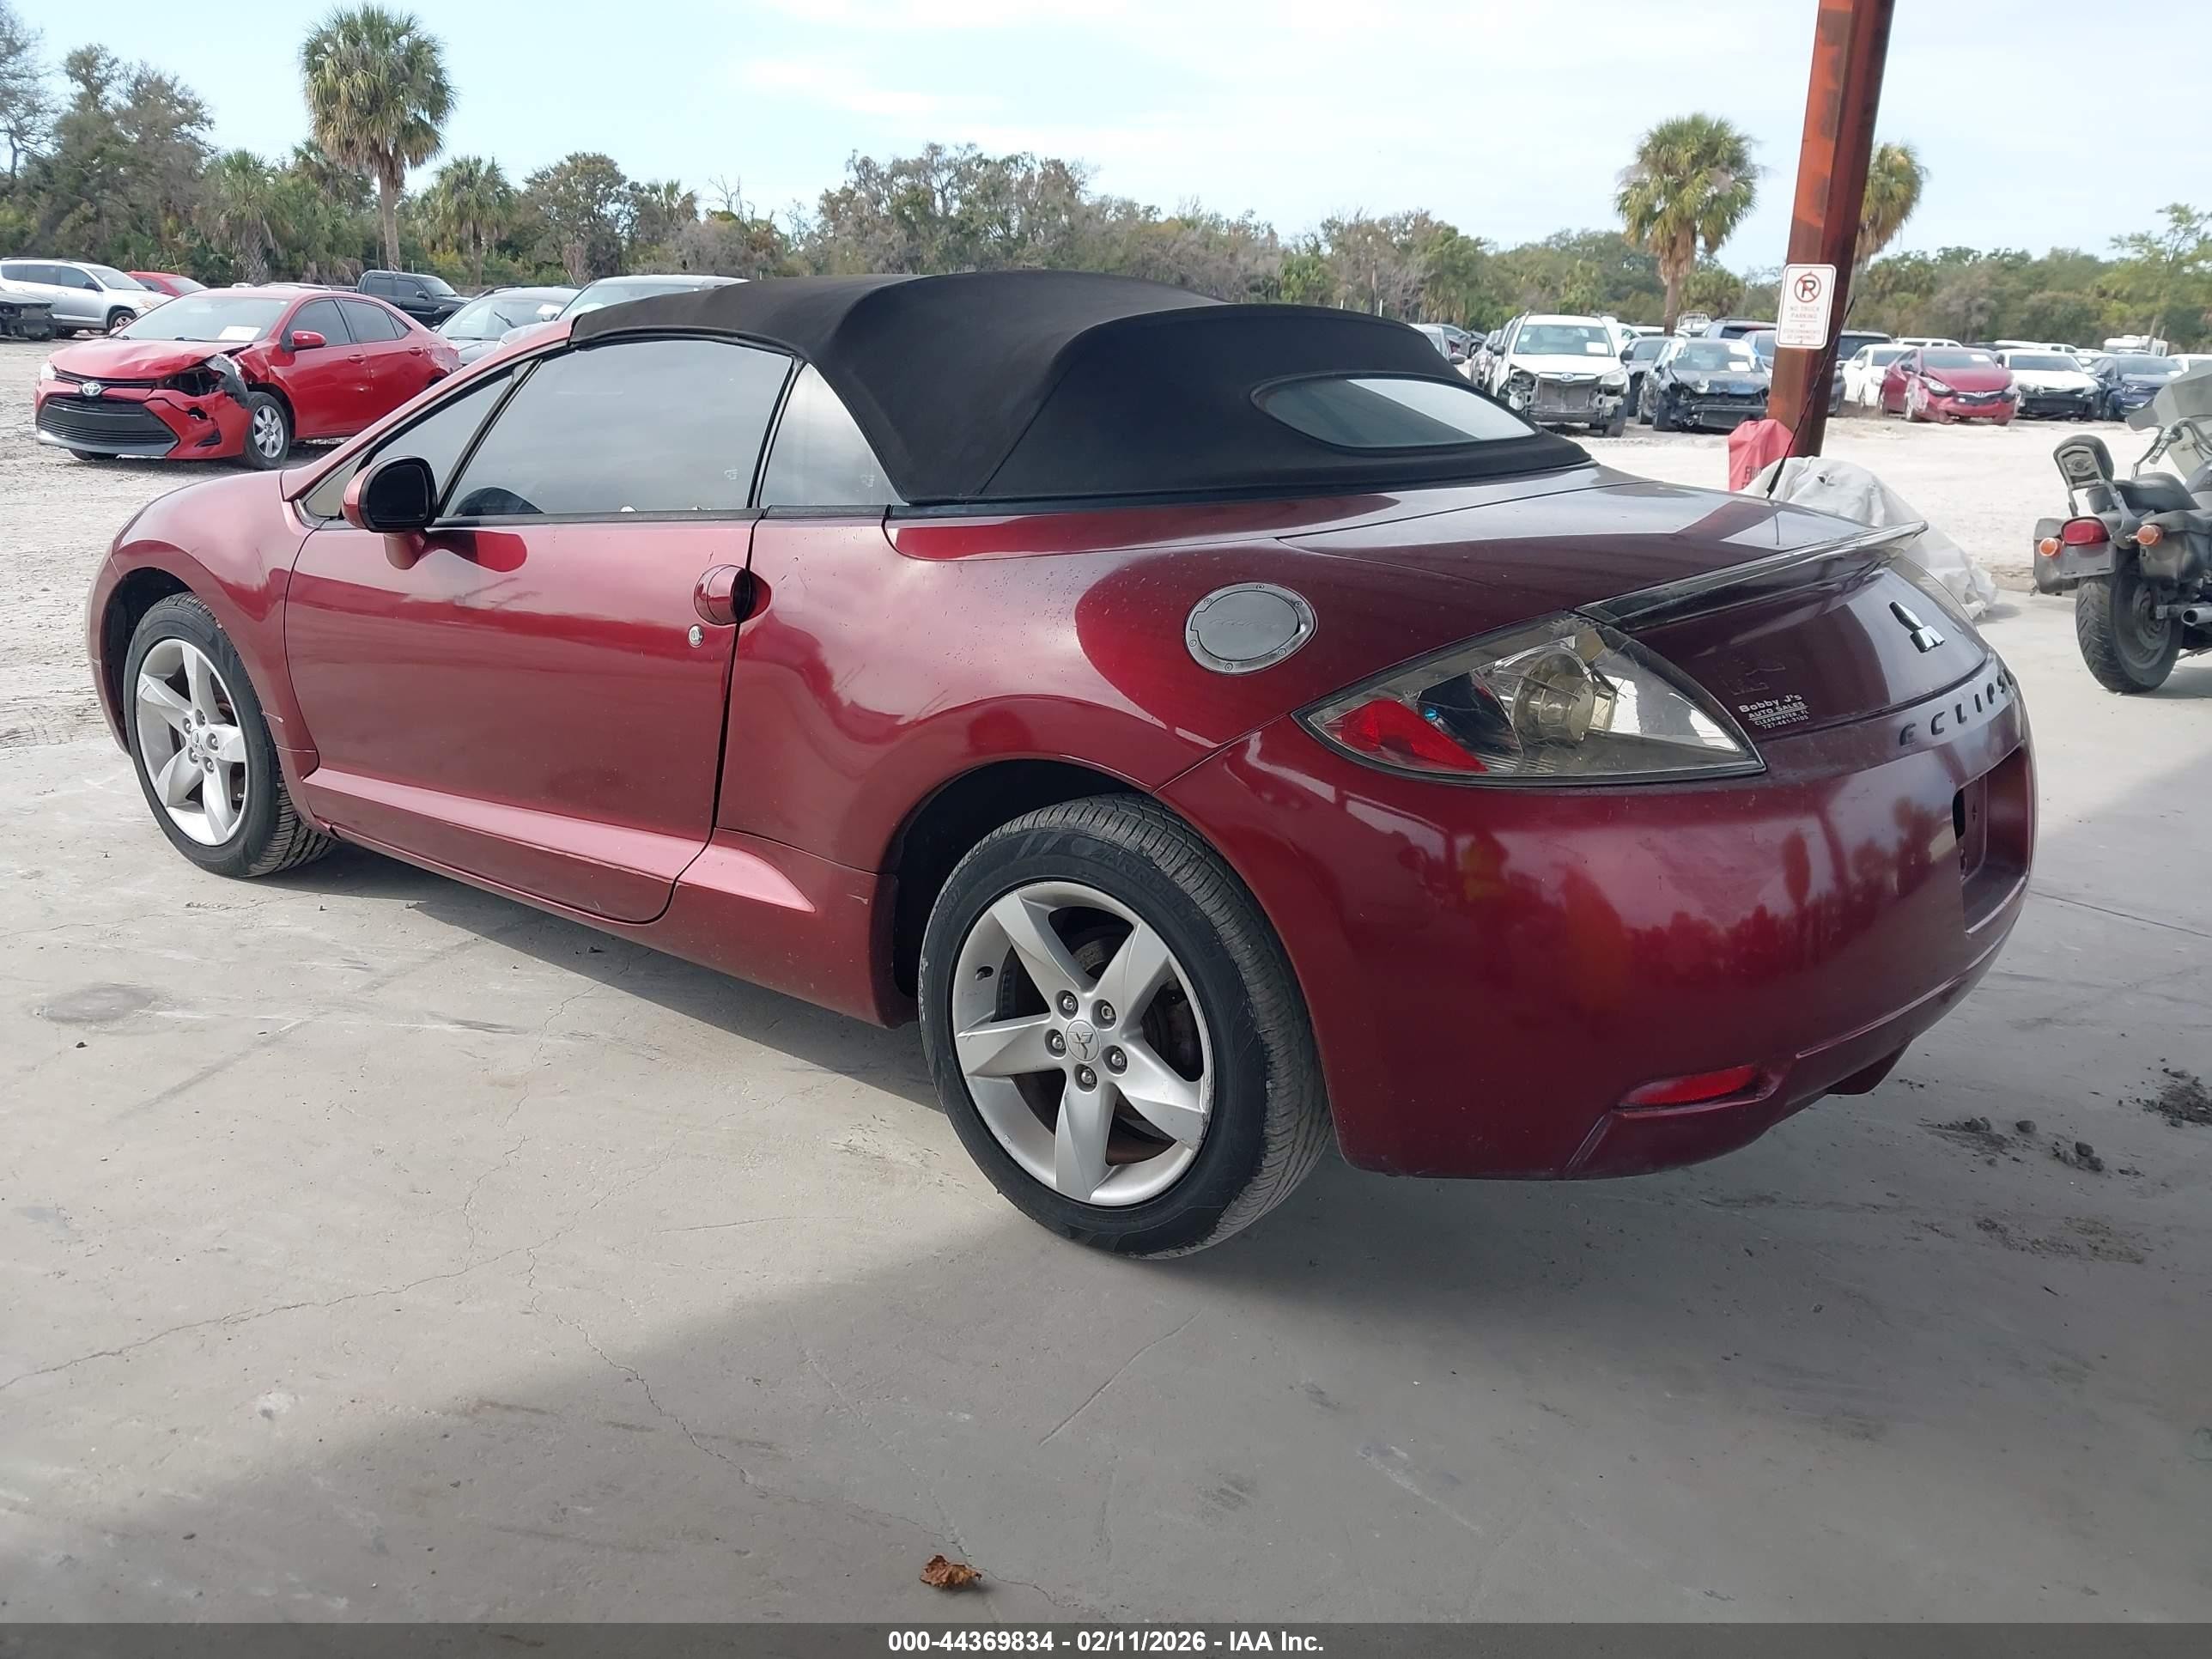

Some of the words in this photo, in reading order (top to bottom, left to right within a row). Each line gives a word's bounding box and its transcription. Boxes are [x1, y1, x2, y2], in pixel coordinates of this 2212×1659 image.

[1738, 699, 1779, 713] Bobby
[1784, 694, 1802, 702] J's
[1748, 708, 1774, 718] AUTO
[1775, 701, 1805, 711] SALES
